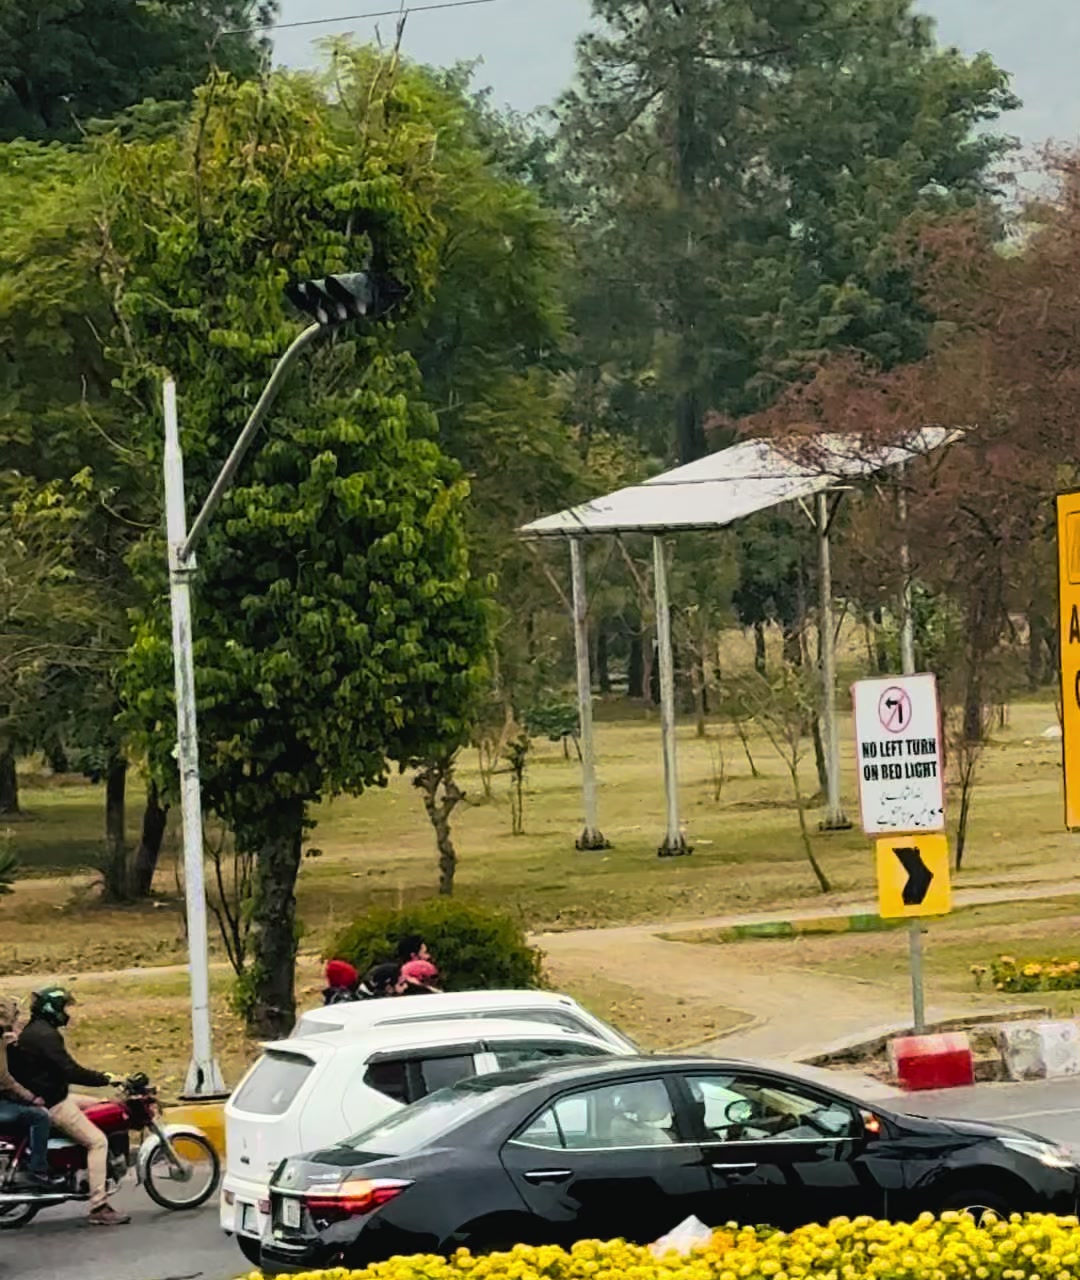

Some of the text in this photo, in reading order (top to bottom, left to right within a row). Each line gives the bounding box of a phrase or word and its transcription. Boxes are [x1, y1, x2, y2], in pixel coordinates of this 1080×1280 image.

[862, 738, 936, 758] NO LEFT TURN
[864, 764, 879, 781] ON
[905, 761, 937, 779] LIGHT
